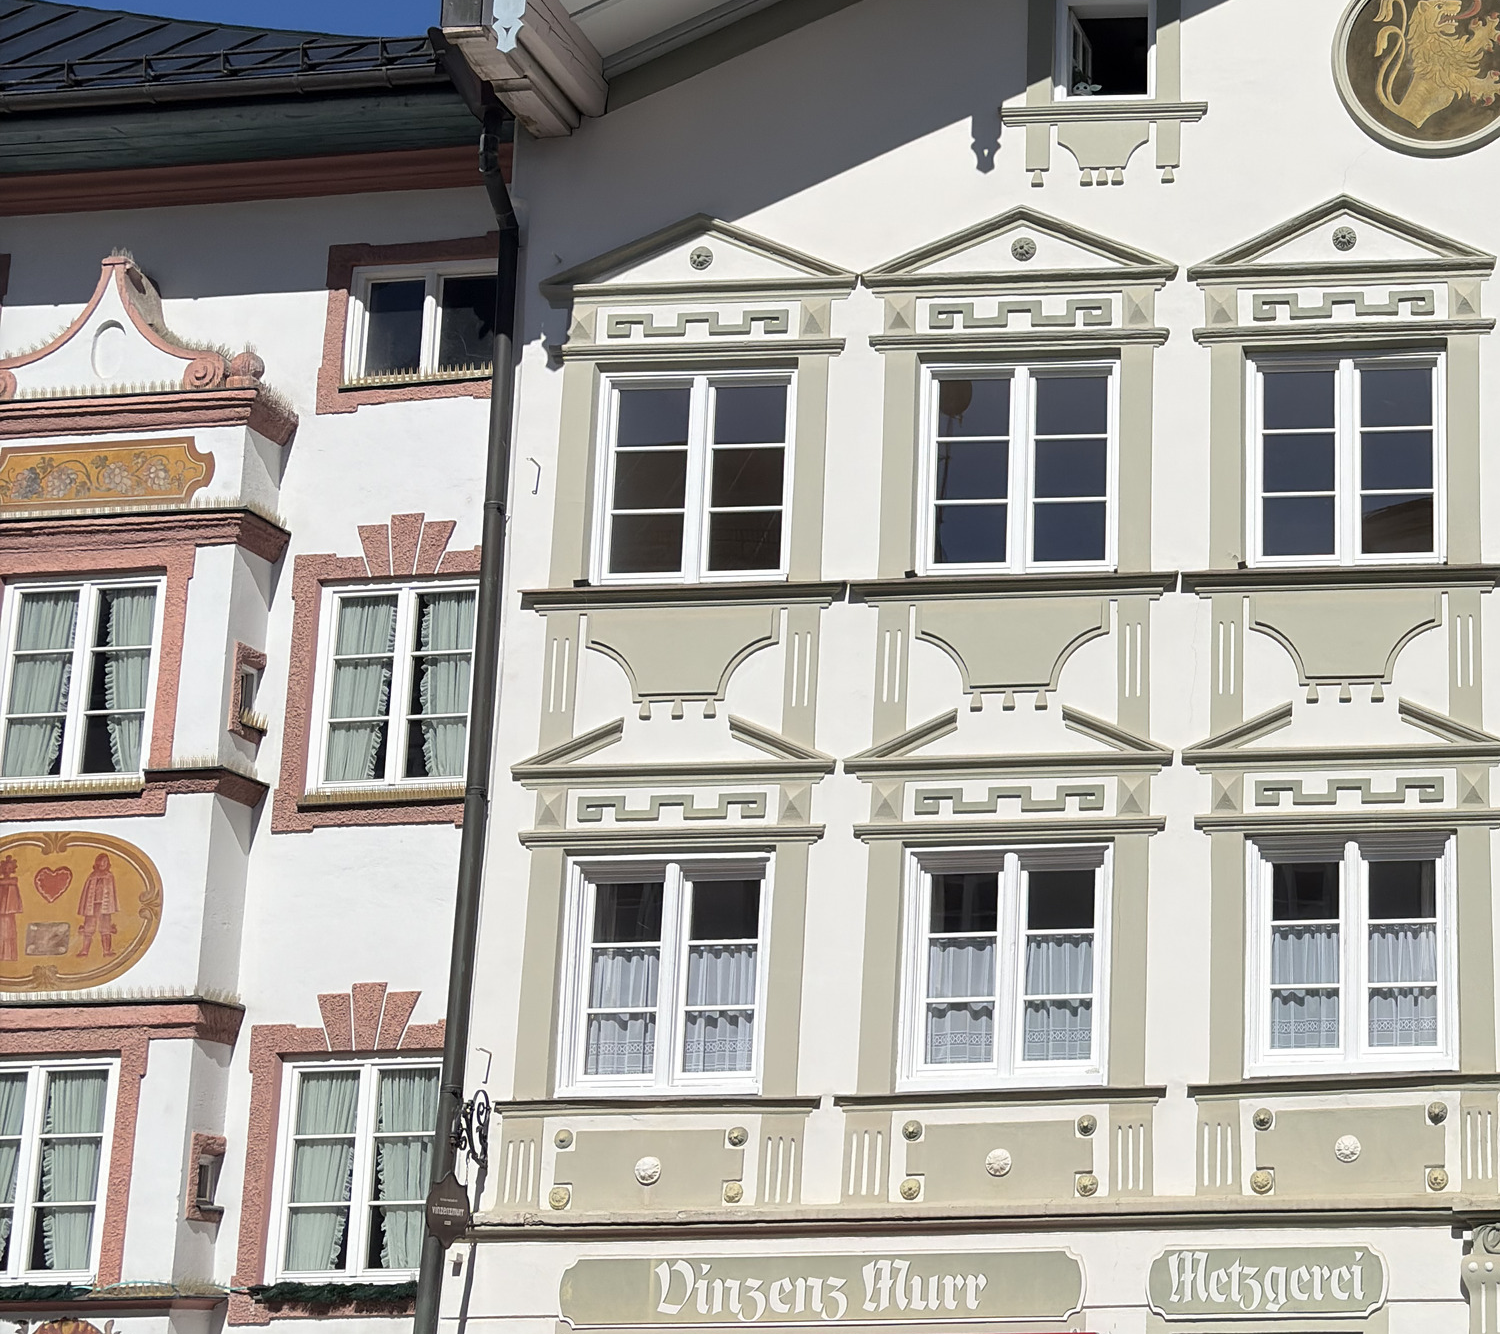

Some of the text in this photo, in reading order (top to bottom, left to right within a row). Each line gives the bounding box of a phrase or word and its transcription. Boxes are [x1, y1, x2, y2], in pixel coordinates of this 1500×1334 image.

[654, 1259, 988, 1322] Vinzenz Murr
[1168, 1250, 1366, 1312] Metzgerei
